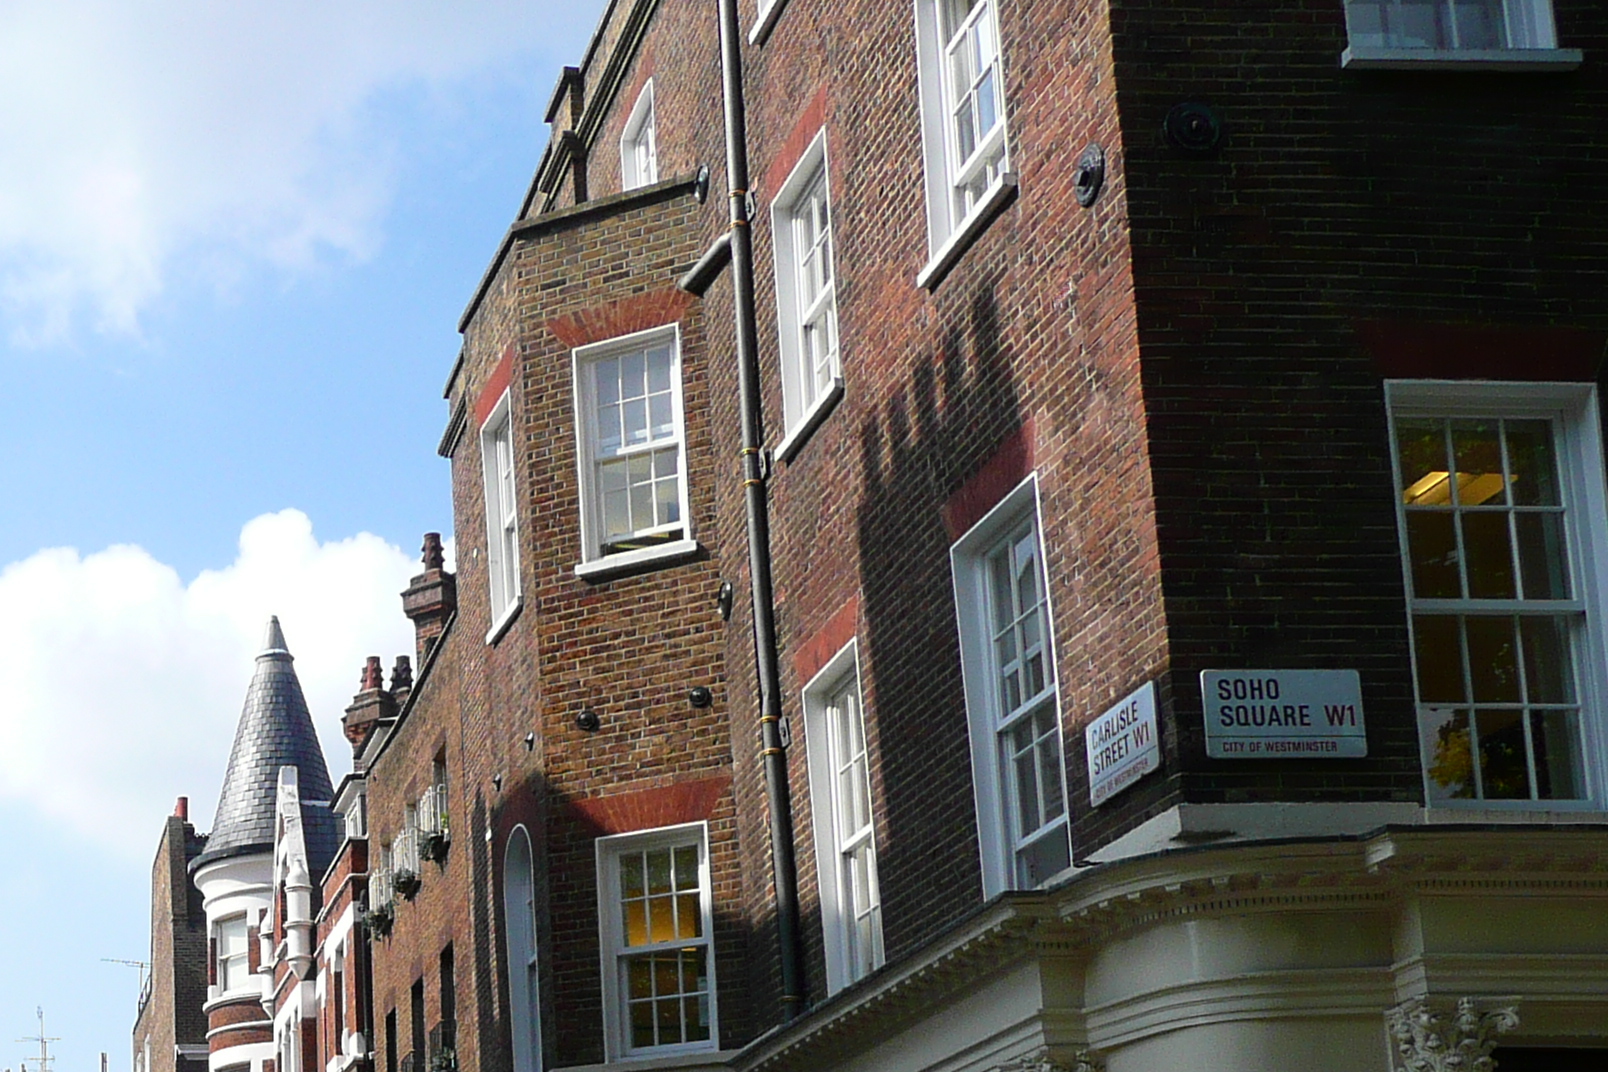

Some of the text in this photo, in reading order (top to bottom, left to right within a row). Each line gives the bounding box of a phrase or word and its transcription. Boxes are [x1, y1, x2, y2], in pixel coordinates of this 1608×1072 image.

[1218, 678, 1280, 700] SOHO
[1091, 700, 1139, 751] CARLISLE
[1220, 704, 1356, 727] SQUARE W1
[1093, 721, 1150, 775] STREET W1
[1223, 741, 1338, 753] CITY OF WESTMINSTER
